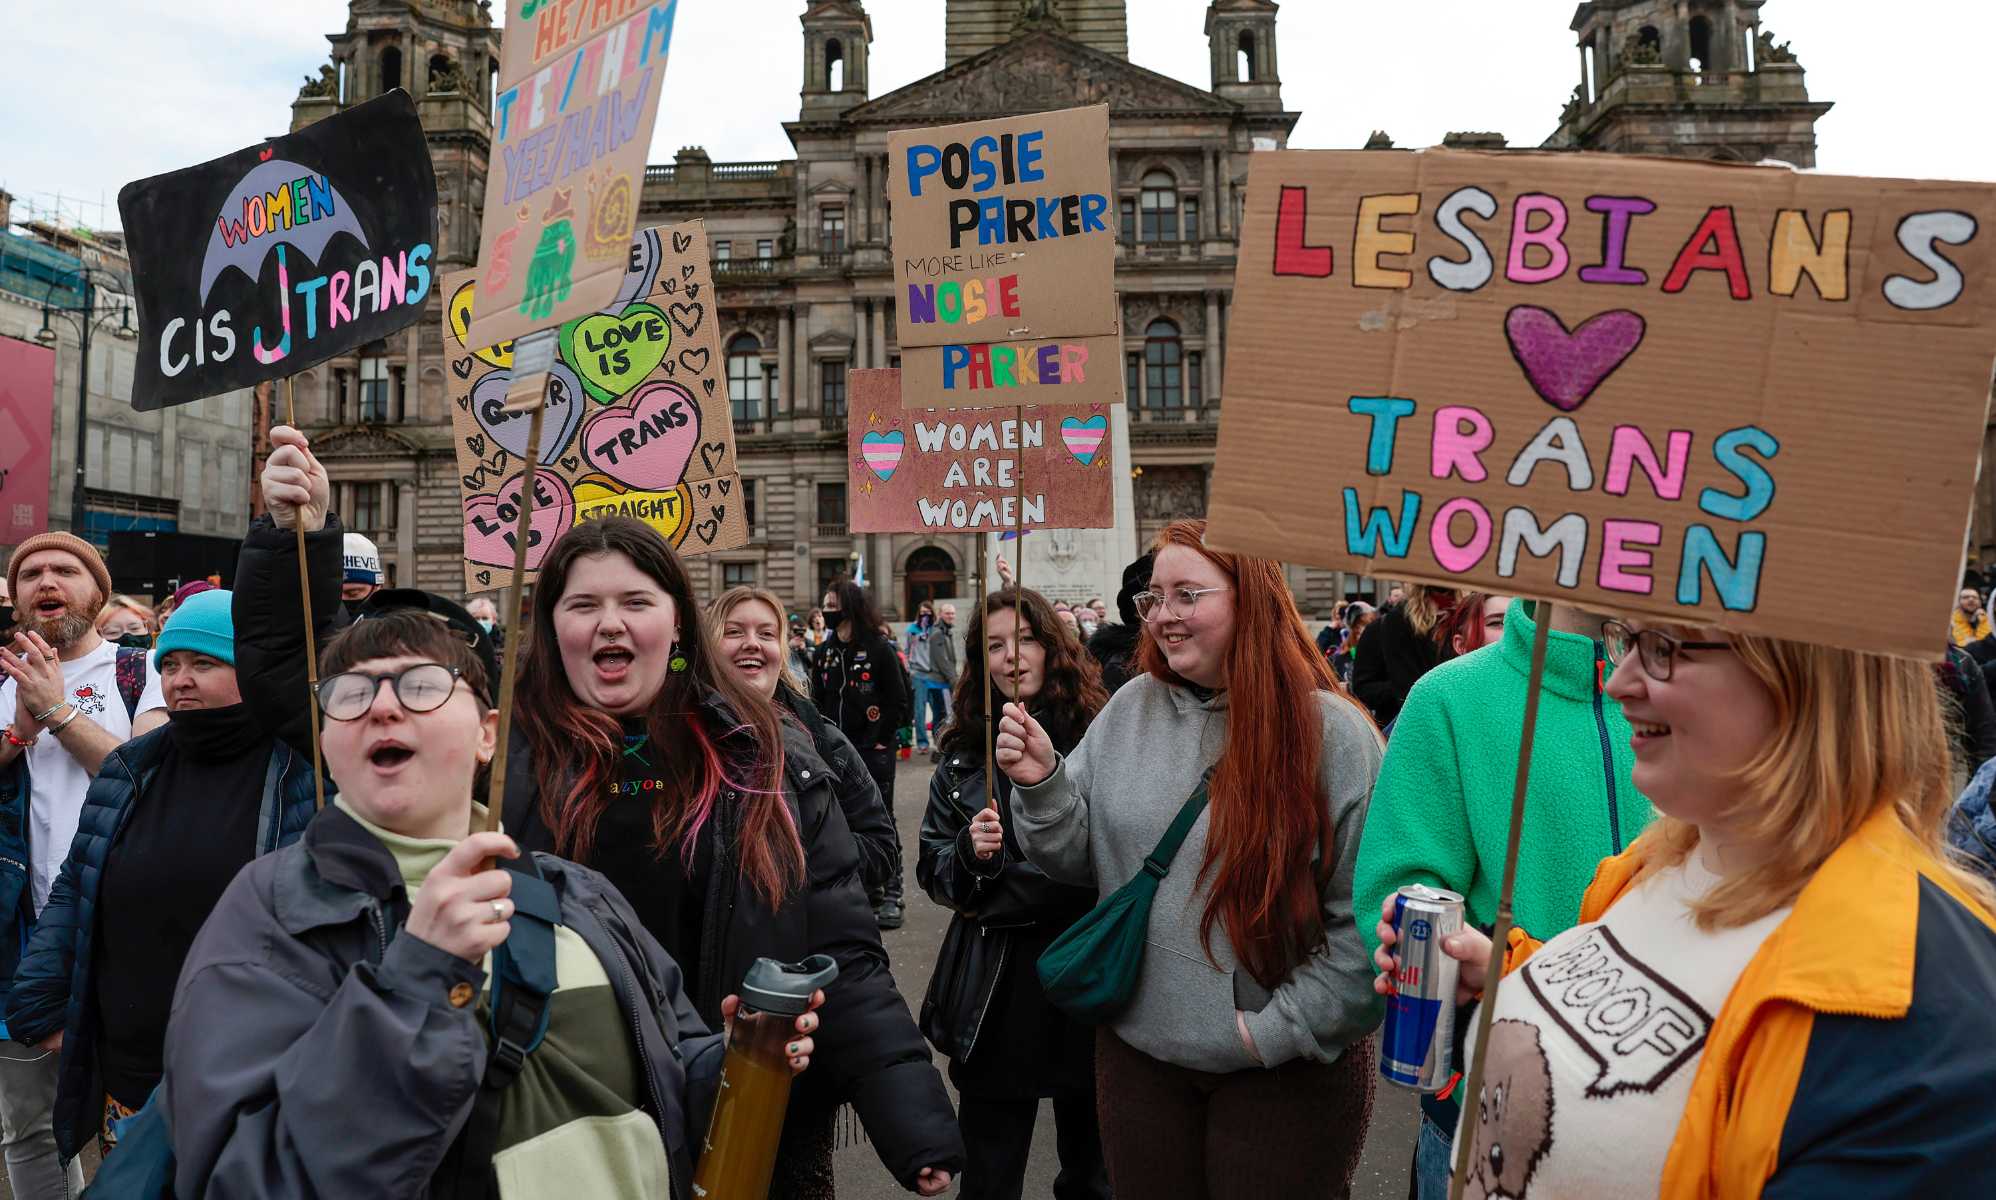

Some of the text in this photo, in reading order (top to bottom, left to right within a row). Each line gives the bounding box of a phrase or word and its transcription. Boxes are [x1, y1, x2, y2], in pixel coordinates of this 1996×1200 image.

[504, 67, 653, 205] YEE/HAW
[907, 130, 1044, 196] POSIE
[219, 176, 335, 248] WOMEN
[950, 194, 1107, 249] PARKER
[905, 253, 1007, 278] MORE LIKE
[1272, 185, 1978, 310] LESBIANS
[160, 243, 432, 377] CIS TRANS
[908, 274, 1020, 324] NOSIE
[585, 318, 664, 352] LOVE
[599, 349, 631, 375] IS
[943, 343, 1089, 390] PARKER
[594, 402, 688, 465] TRANS
[913, 420, 1043, 452] WOMEN
[1348, 396, 1780, 521] TRANS
[943, 457, 1015, 488] ARE
[917, 493, 1045, 528] WOMEN
[1343, 487, 1766, 613] WOMEN
[1538, 933, 1695, 1056] WOOF
